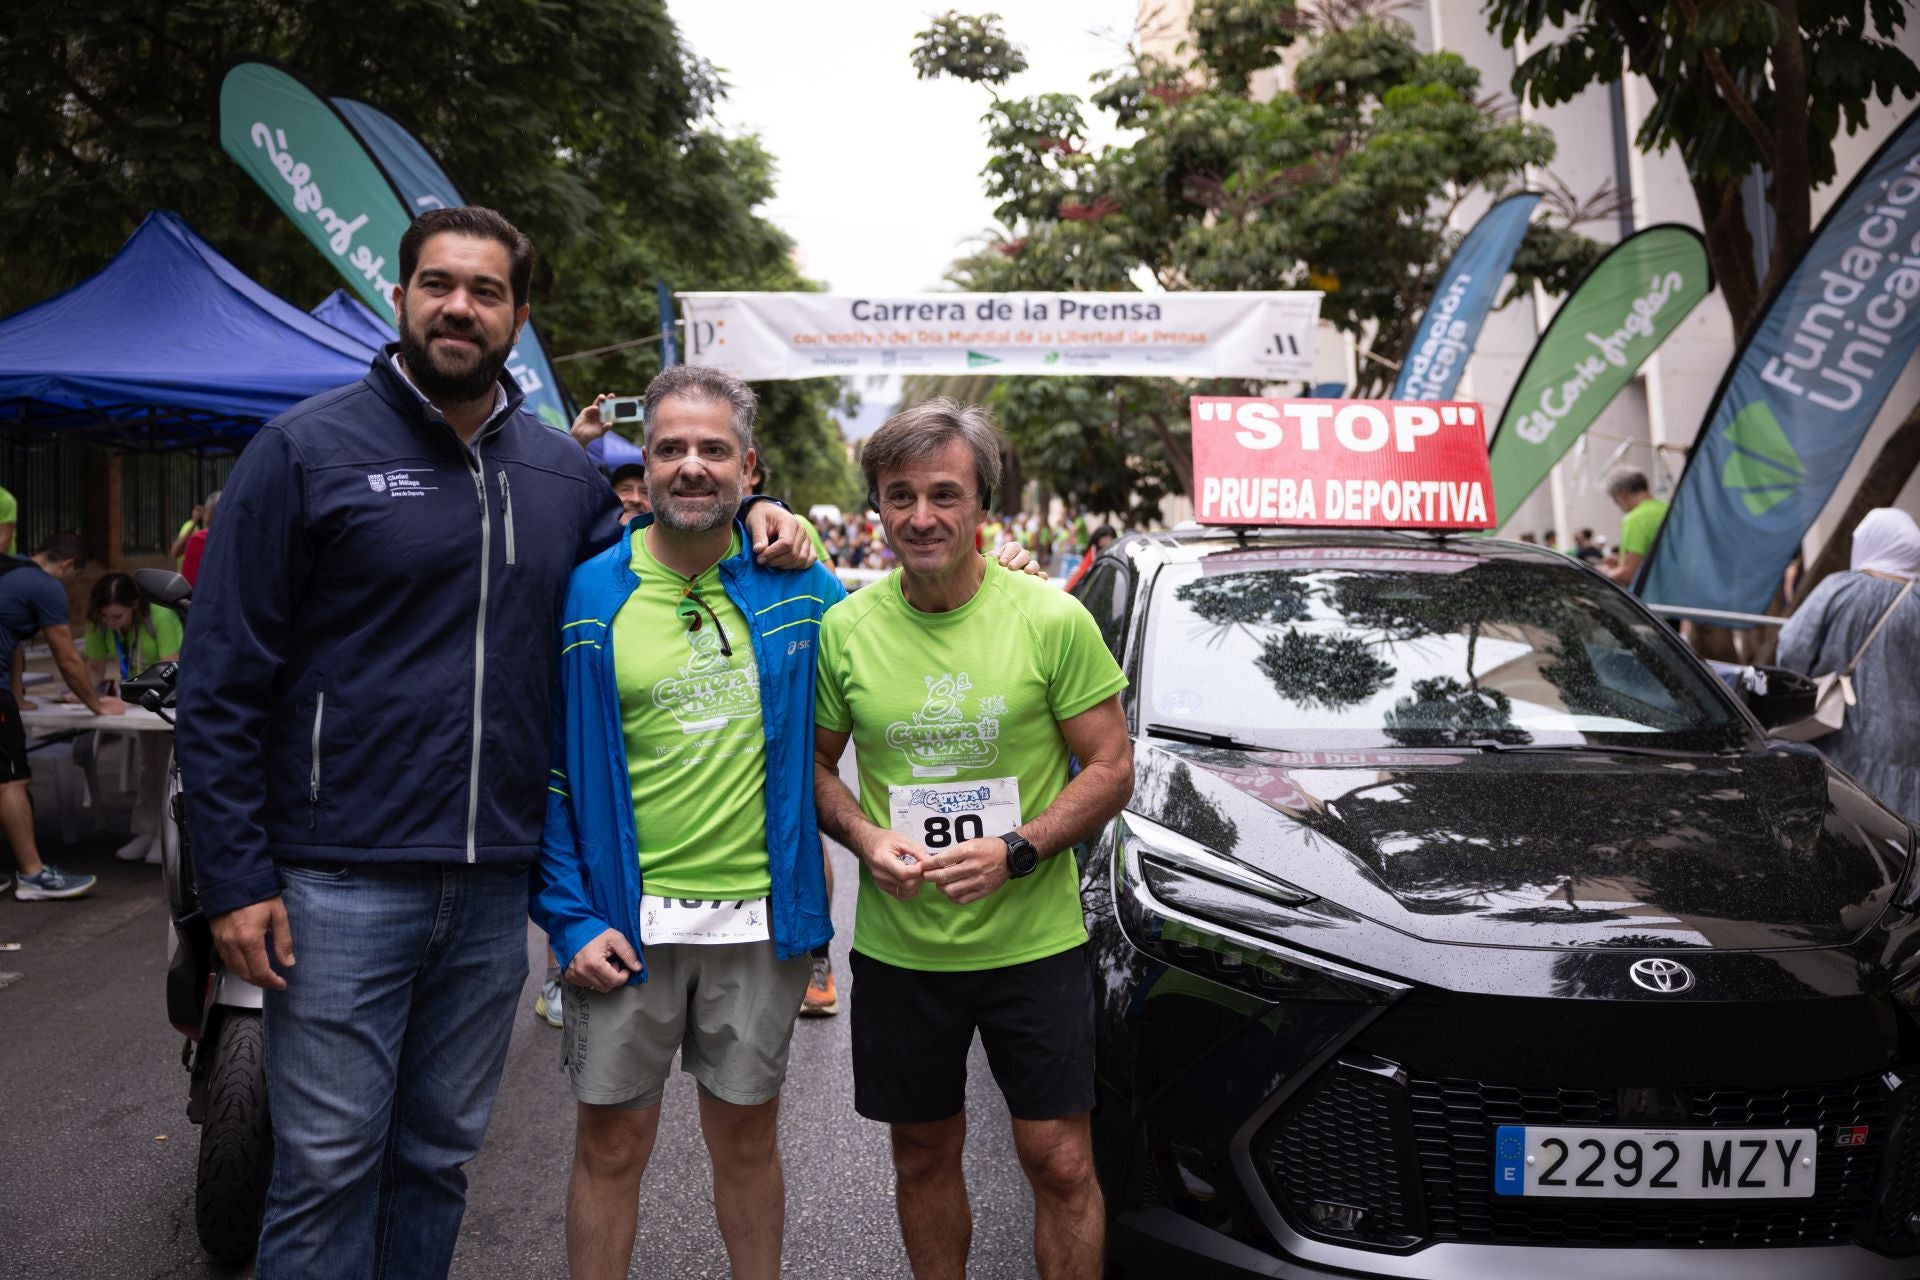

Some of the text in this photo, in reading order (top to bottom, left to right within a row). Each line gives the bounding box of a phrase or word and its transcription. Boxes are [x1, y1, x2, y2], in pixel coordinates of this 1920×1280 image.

[851, 298, 1161, 321] Carrera de la Prensa
[1057, 330, 1124, 345] Libertad
[1152, 331, 1206, 346] Prensa
[1541, 354, 1607, 418] Corte
[1585, 271, 1684, 368] Inglés
[1197, 402, 1476, 453] "STOP"
[386, 473, 409, 481] Ciudad
[1201, 476, 1488, 523] PRUEBA DEPORTIVA
[890, 724, 981, 744] Carrera
[924, 788, 980, 806] Carrera
[937, 799, 985, 813] Prensa
[924, 814, 984, 848] 80
[1838, 1133, 1866, 1145] GR
[1538, 1137, 1803, 1189] 2292 MZY
[1503, 1167, 1516, 1181] E
